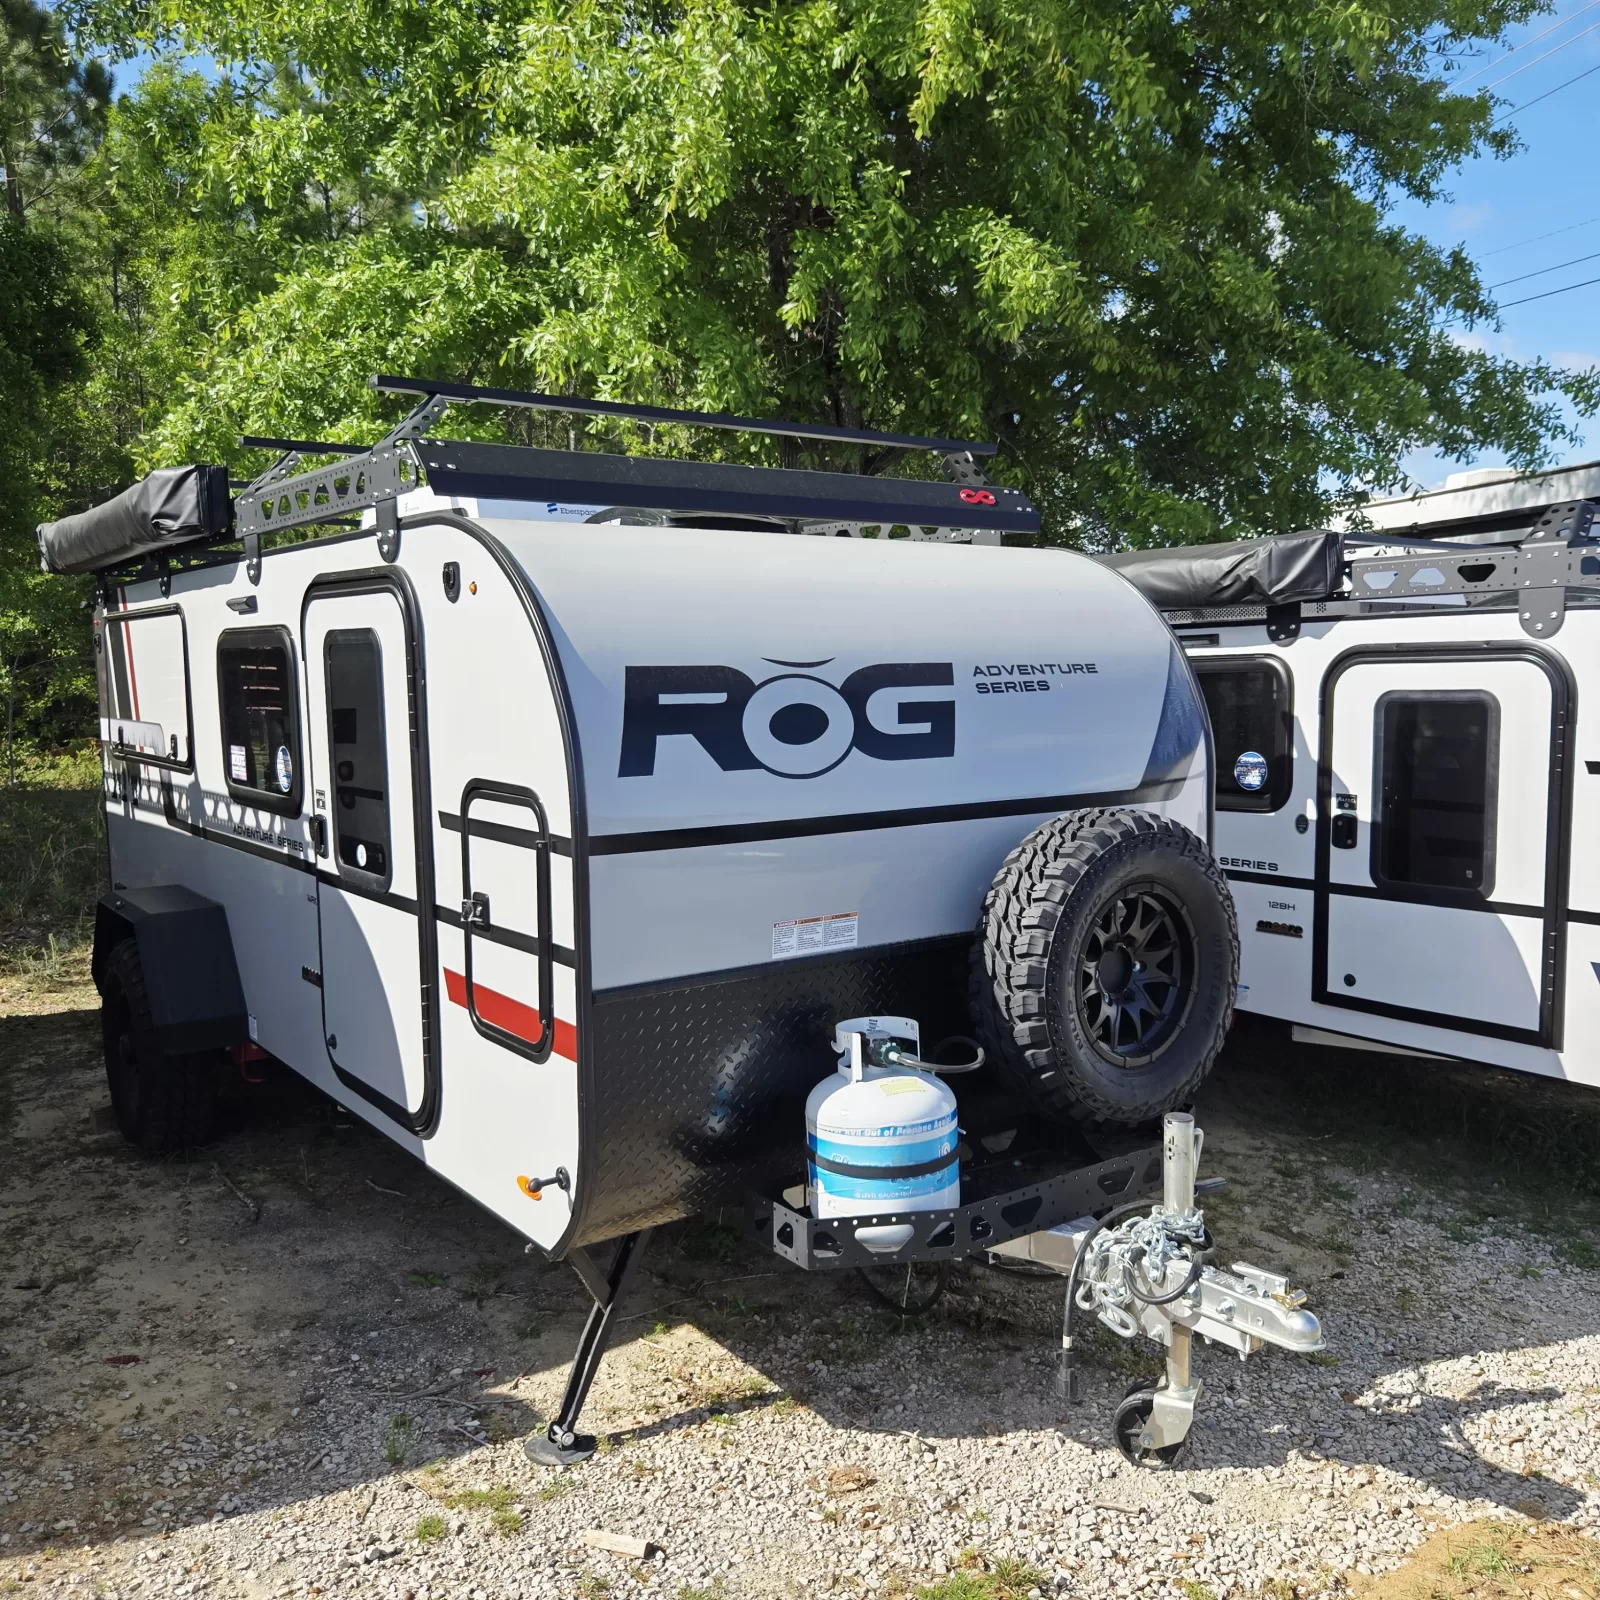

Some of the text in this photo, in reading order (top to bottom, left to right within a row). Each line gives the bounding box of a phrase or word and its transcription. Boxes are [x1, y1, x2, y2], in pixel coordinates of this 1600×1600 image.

[973, 662, 1098, 678] ADVENTURE
[975, 679, 1050, 694] SERIES
[233, 824, 304, 852] ADVENTURE SERIES
[1219, 856, 1279, 872] SERIES
[1267, 900, 1297, 911] 12BH
[884, 1126, 895, 1137] of
